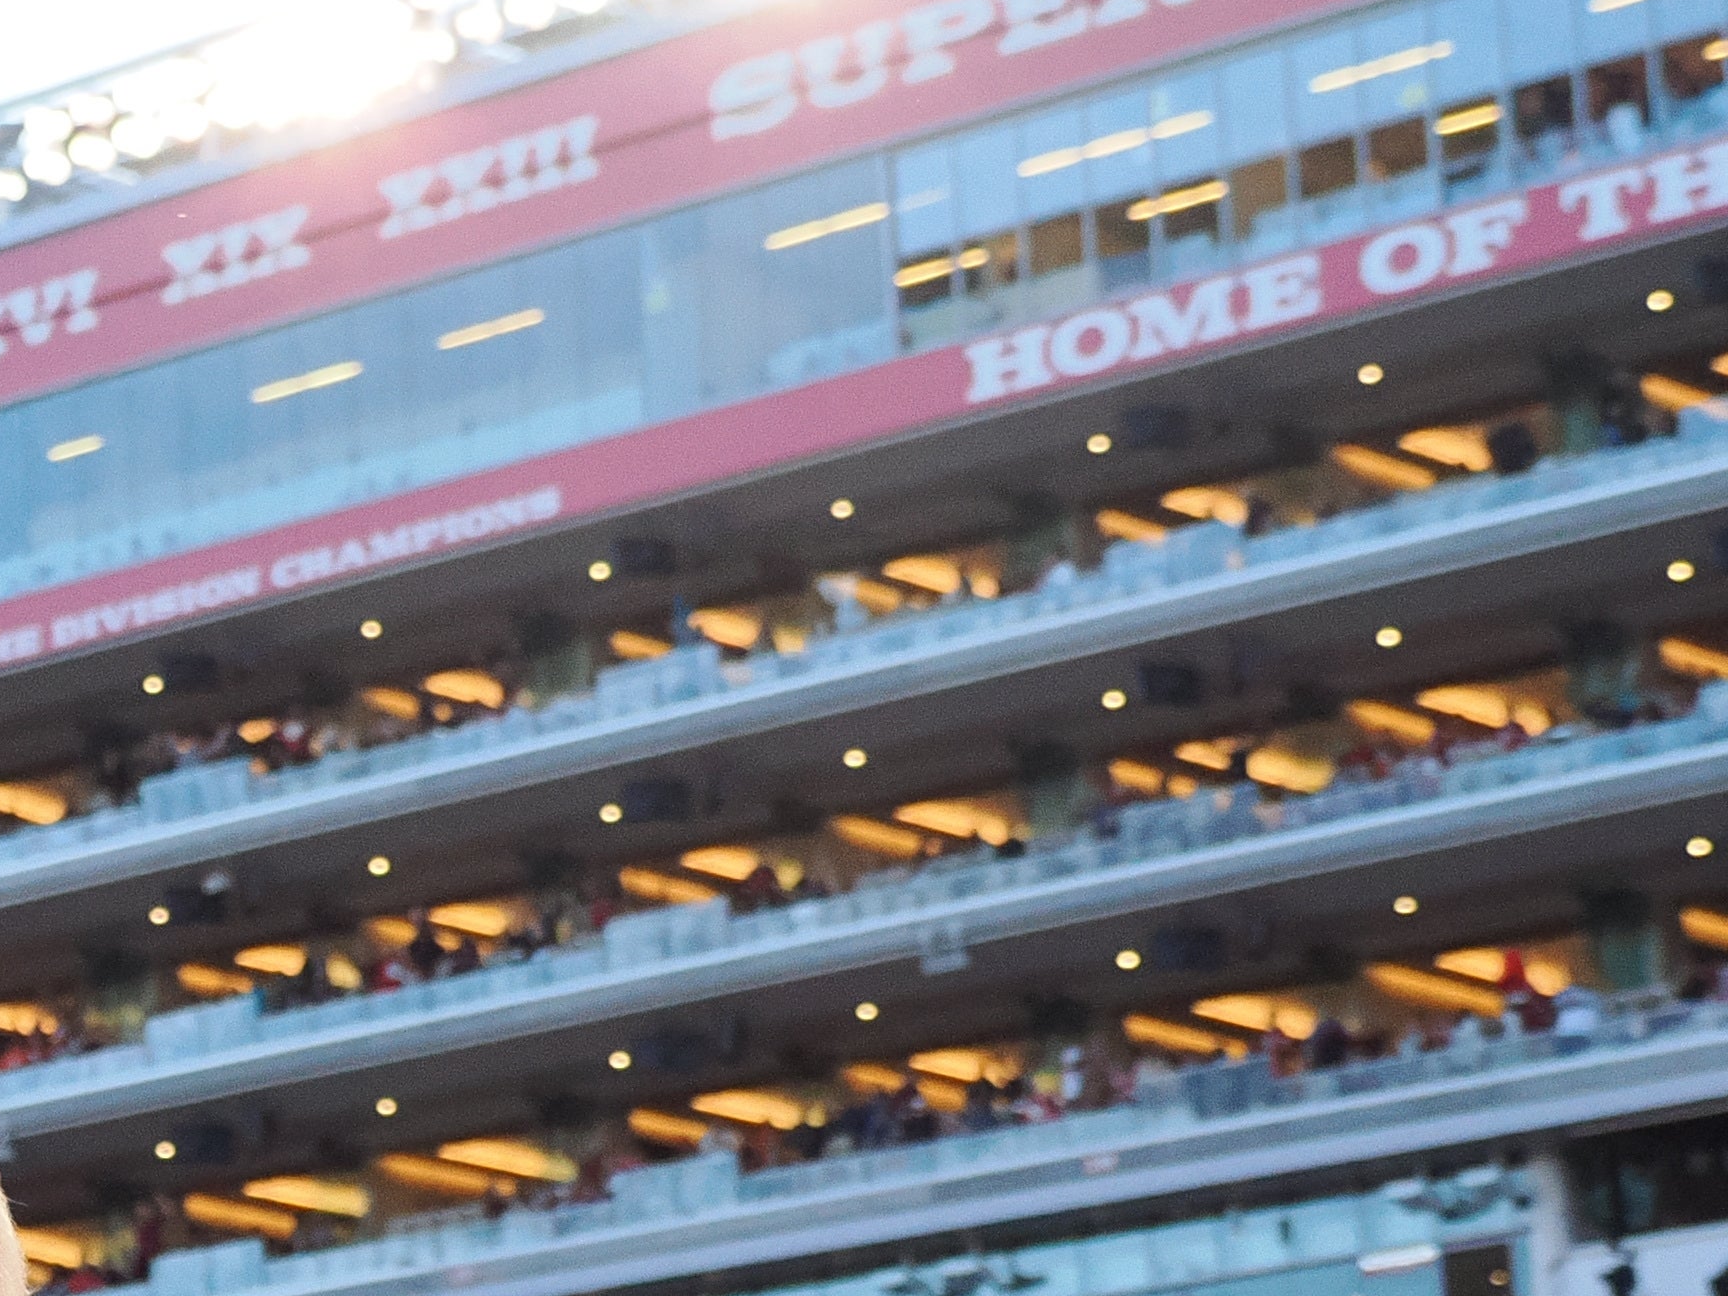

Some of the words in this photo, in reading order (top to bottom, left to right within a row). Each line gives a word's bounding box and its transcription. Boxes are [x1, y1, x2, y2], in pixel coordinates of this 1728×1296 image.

[161, 206, 311, 305] XIX
[965, 257, 1324, 403] HOME
[1358, 198, 1530, 297] OF
[52, 565, 260, 651] DIVISION
[270, 487, 562, 588] CHAMPIONS
